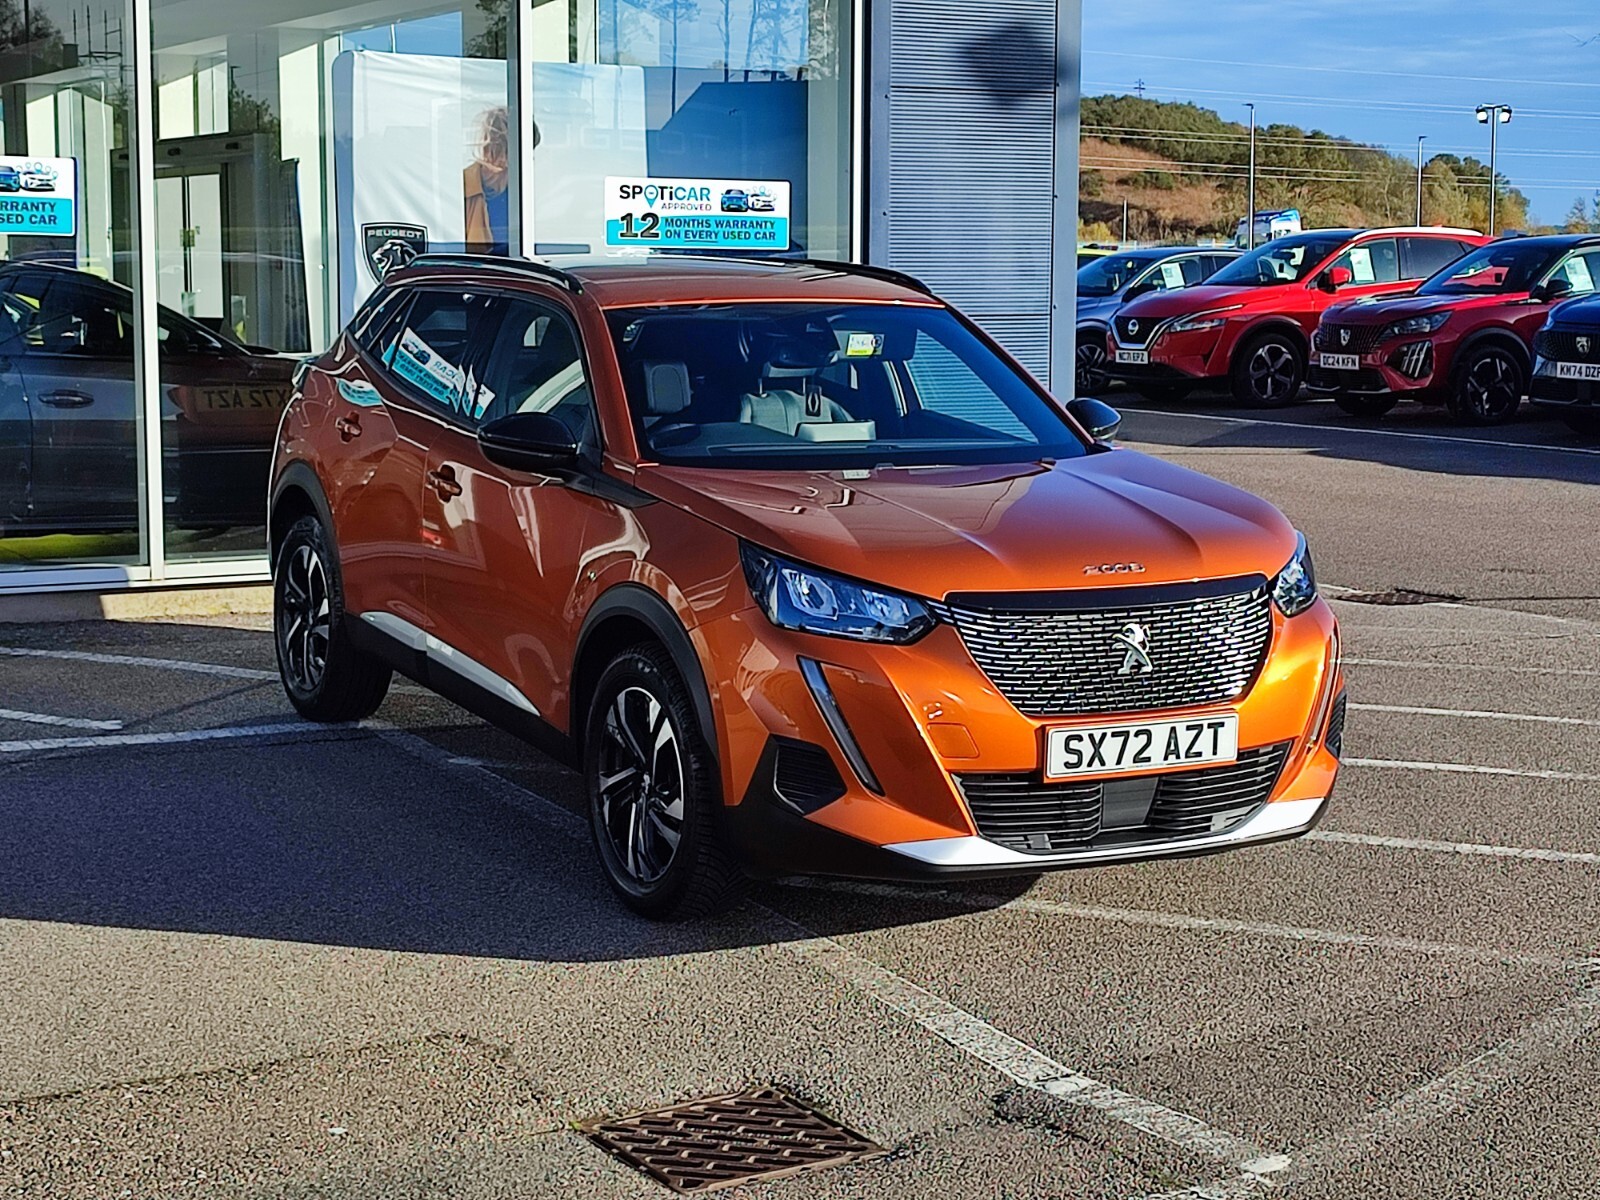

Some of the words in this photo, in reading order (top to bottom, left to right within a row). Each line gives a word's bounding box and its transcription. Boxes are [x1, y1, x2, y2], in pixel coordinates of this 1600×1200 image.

[661, 202, 712, 212] APPROVED
[29, 214, 57, 225] CAR
[664, 218, 711, 229] MONTHS
[715, 219, 776, 230] WARRANTY
[619, 212, 660, 239] 12
[367, 229, 423, 239] PEUGEOT
[665, 230, 681, 239] ON
[684, 230, 719, 240] EVERY
[722, 231, 751, 241] USED
[754, 231, 776, 241] CAR
[1063, 729, 1152, 769] SX72
[1163, 722, 1225, 762] AZT
